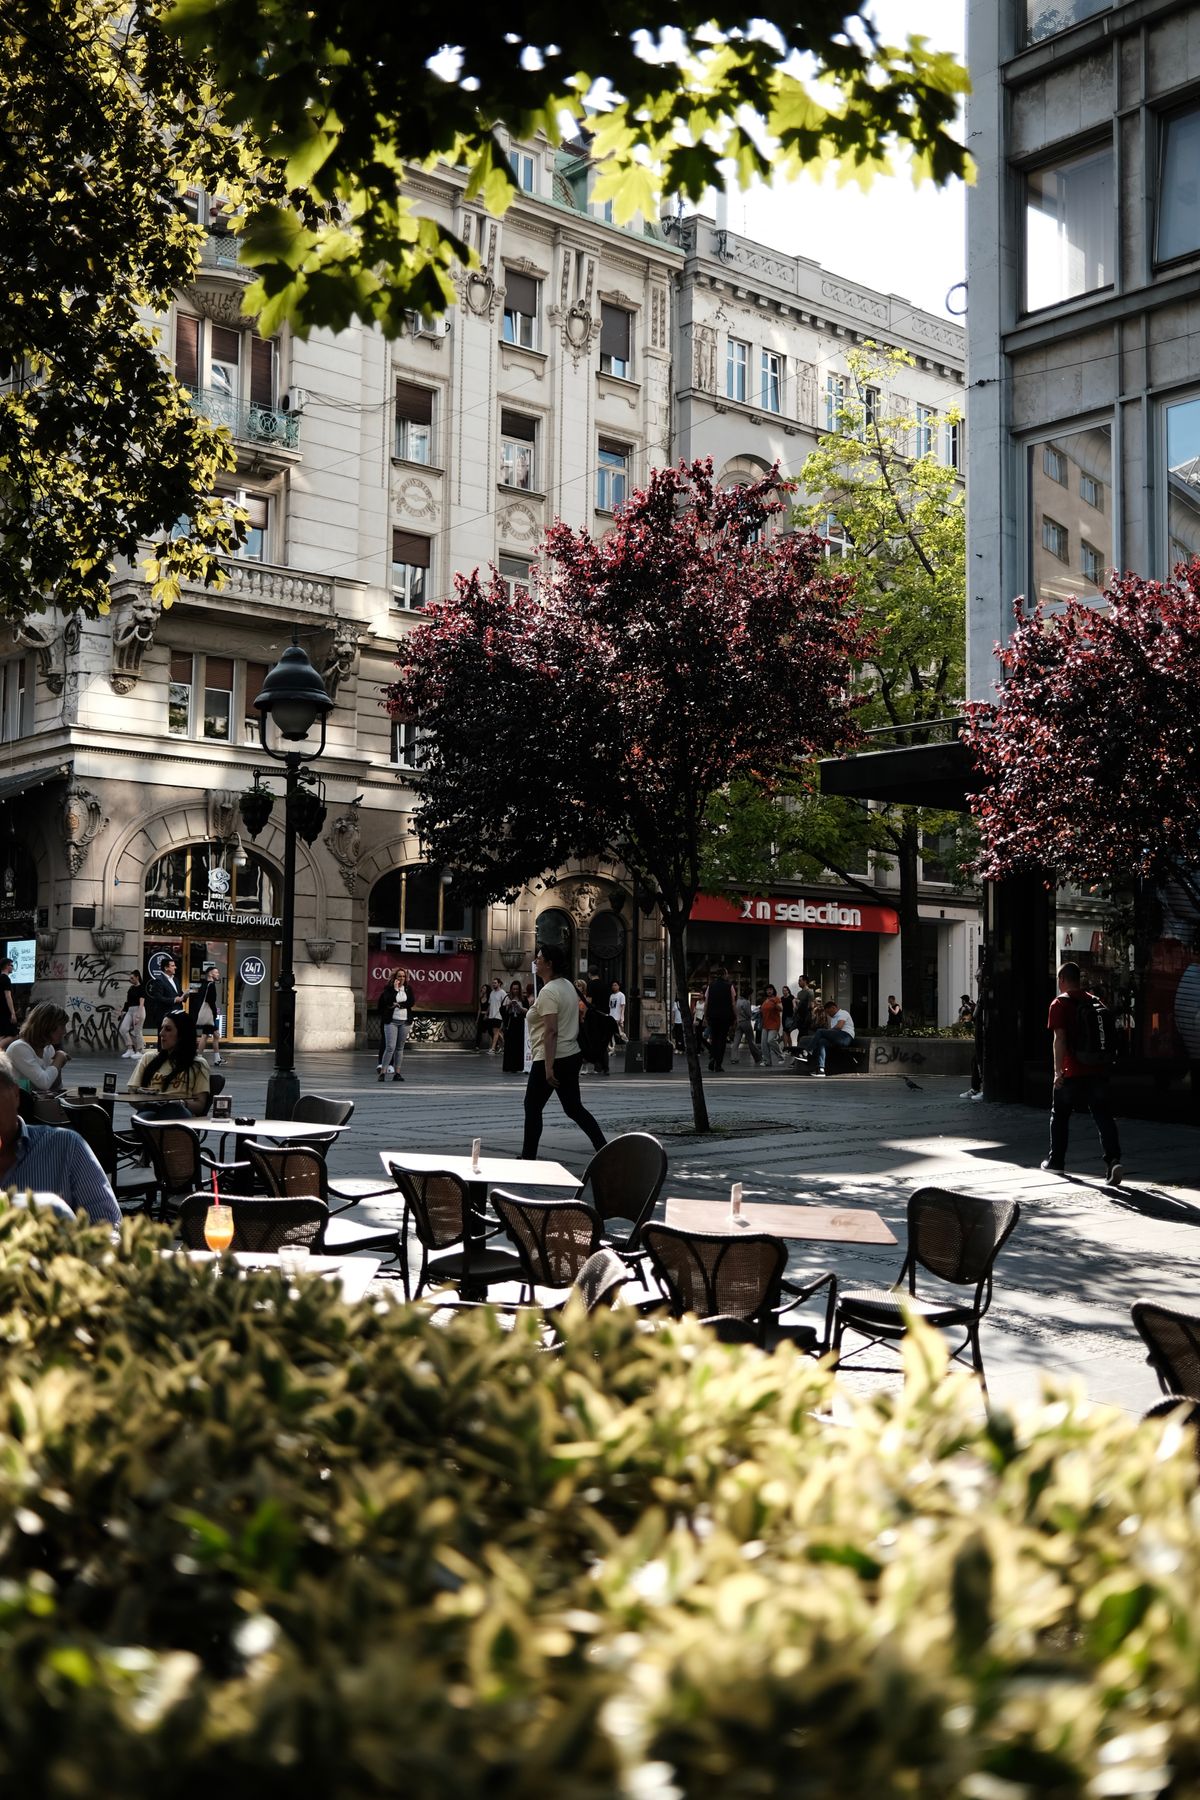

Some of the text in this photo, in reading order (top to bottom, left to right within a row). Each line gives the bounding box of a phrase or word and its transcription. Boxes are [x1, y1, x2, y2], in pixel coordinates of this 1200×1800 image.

[203, 900, 235, 912] БАНКА
[774, 899, 861, 926] selection
[151, 908, 281, 927] ПОШТАНСКА ШТЕДИОНИЦА
[1064, 932, 1073, 947] A1
[244, 962, 262, 974] 24/7
[372, 967, 463, 983] CONG SOON
